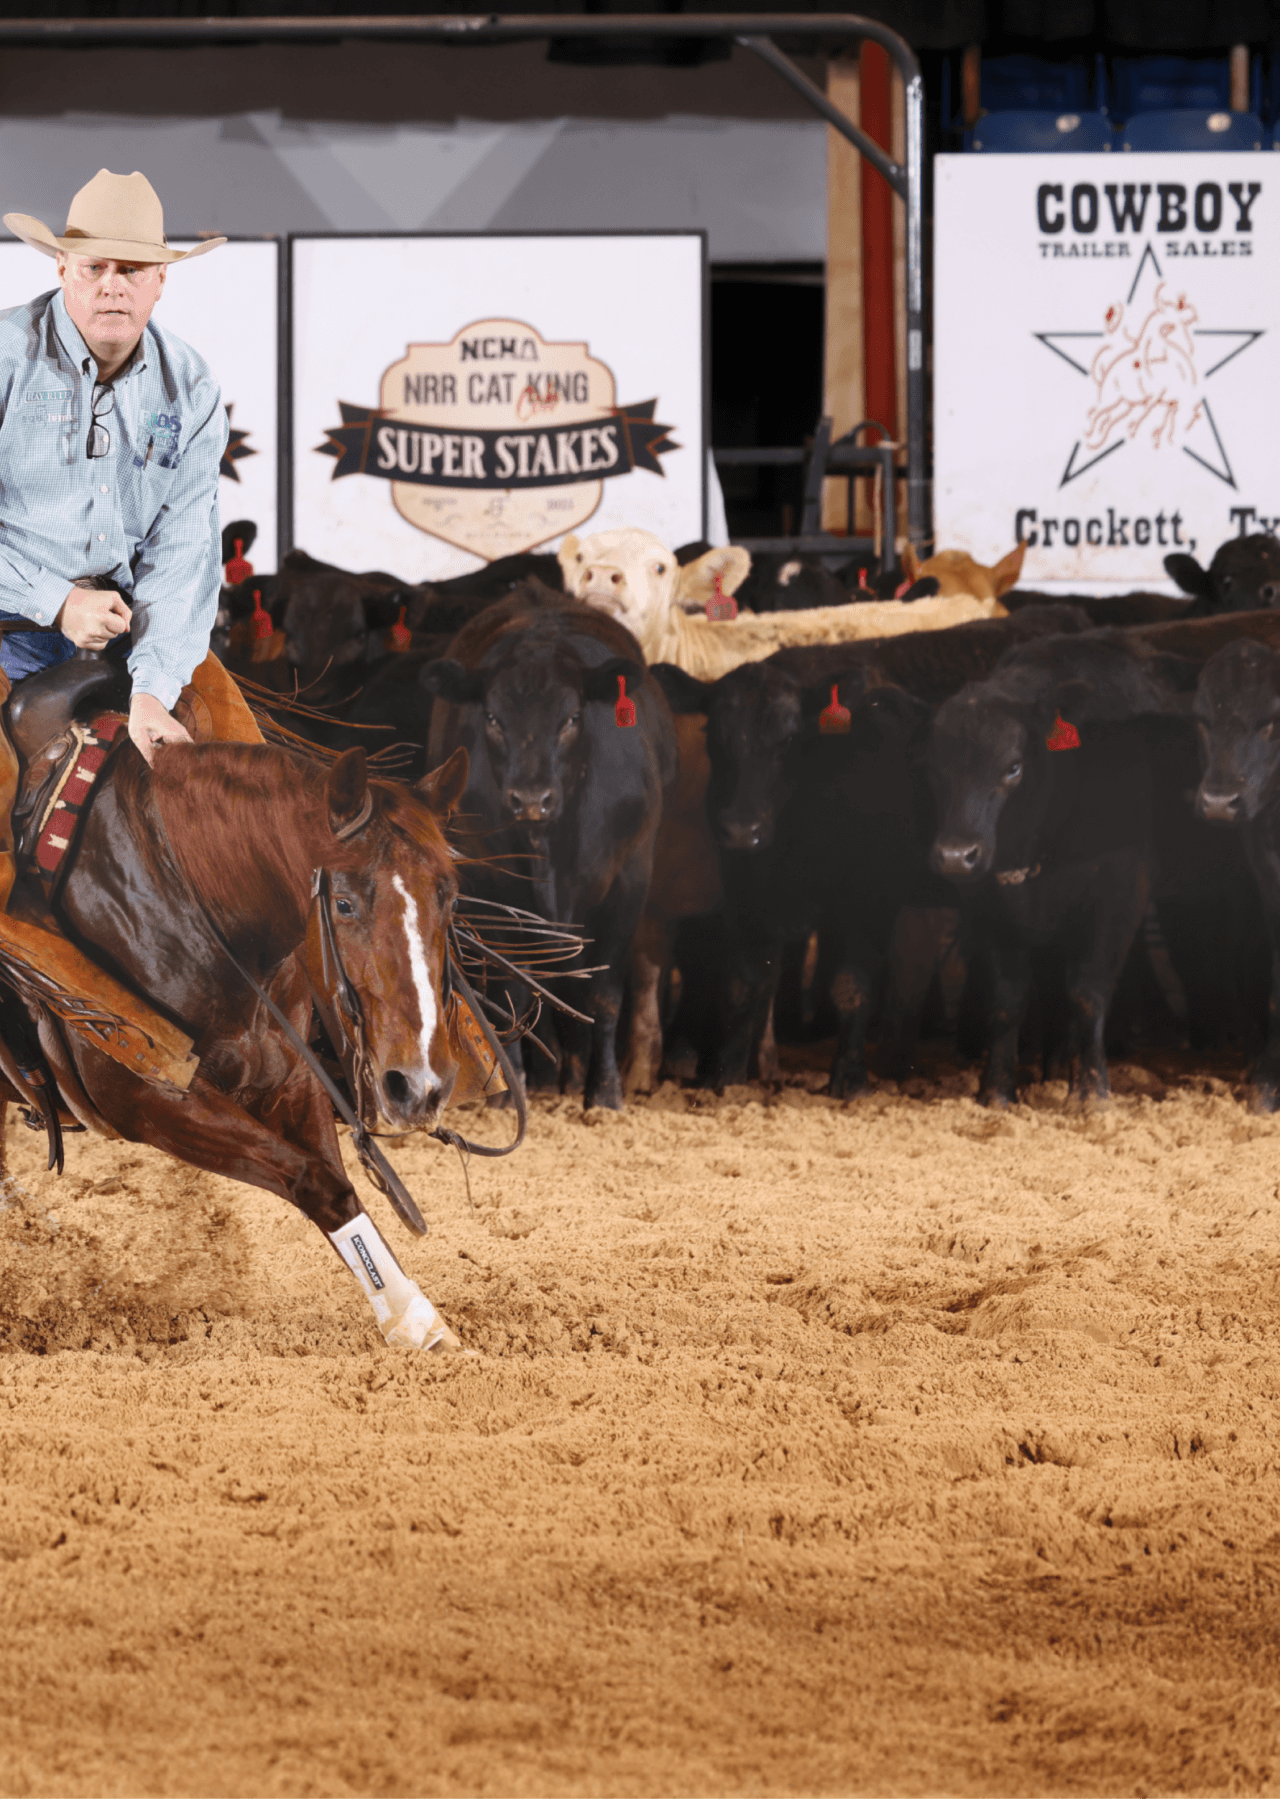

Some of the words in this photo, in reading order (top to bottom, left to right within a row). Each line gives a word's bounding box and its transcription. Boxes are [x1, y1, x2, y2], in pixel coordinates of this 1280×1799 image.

[1036, 182, 1262, 234] COWBOY
[1039, 242, 1131, 258] TRAILER
[1166, 241, 1253, 257] SALES
[460, 337, 539, 362] NCHA
[403, 373, 457, 405] NRR
[468, 373, 516, 405] CAT
[527, 371, 590, 405] KING
[377, 426, 487, 478] SUPER
[495, 425, 619, 479] STAKES
[1014, 507, 1197, 554] Crockett,
[353, 1236, 383, 1288] ICONOCLAST
